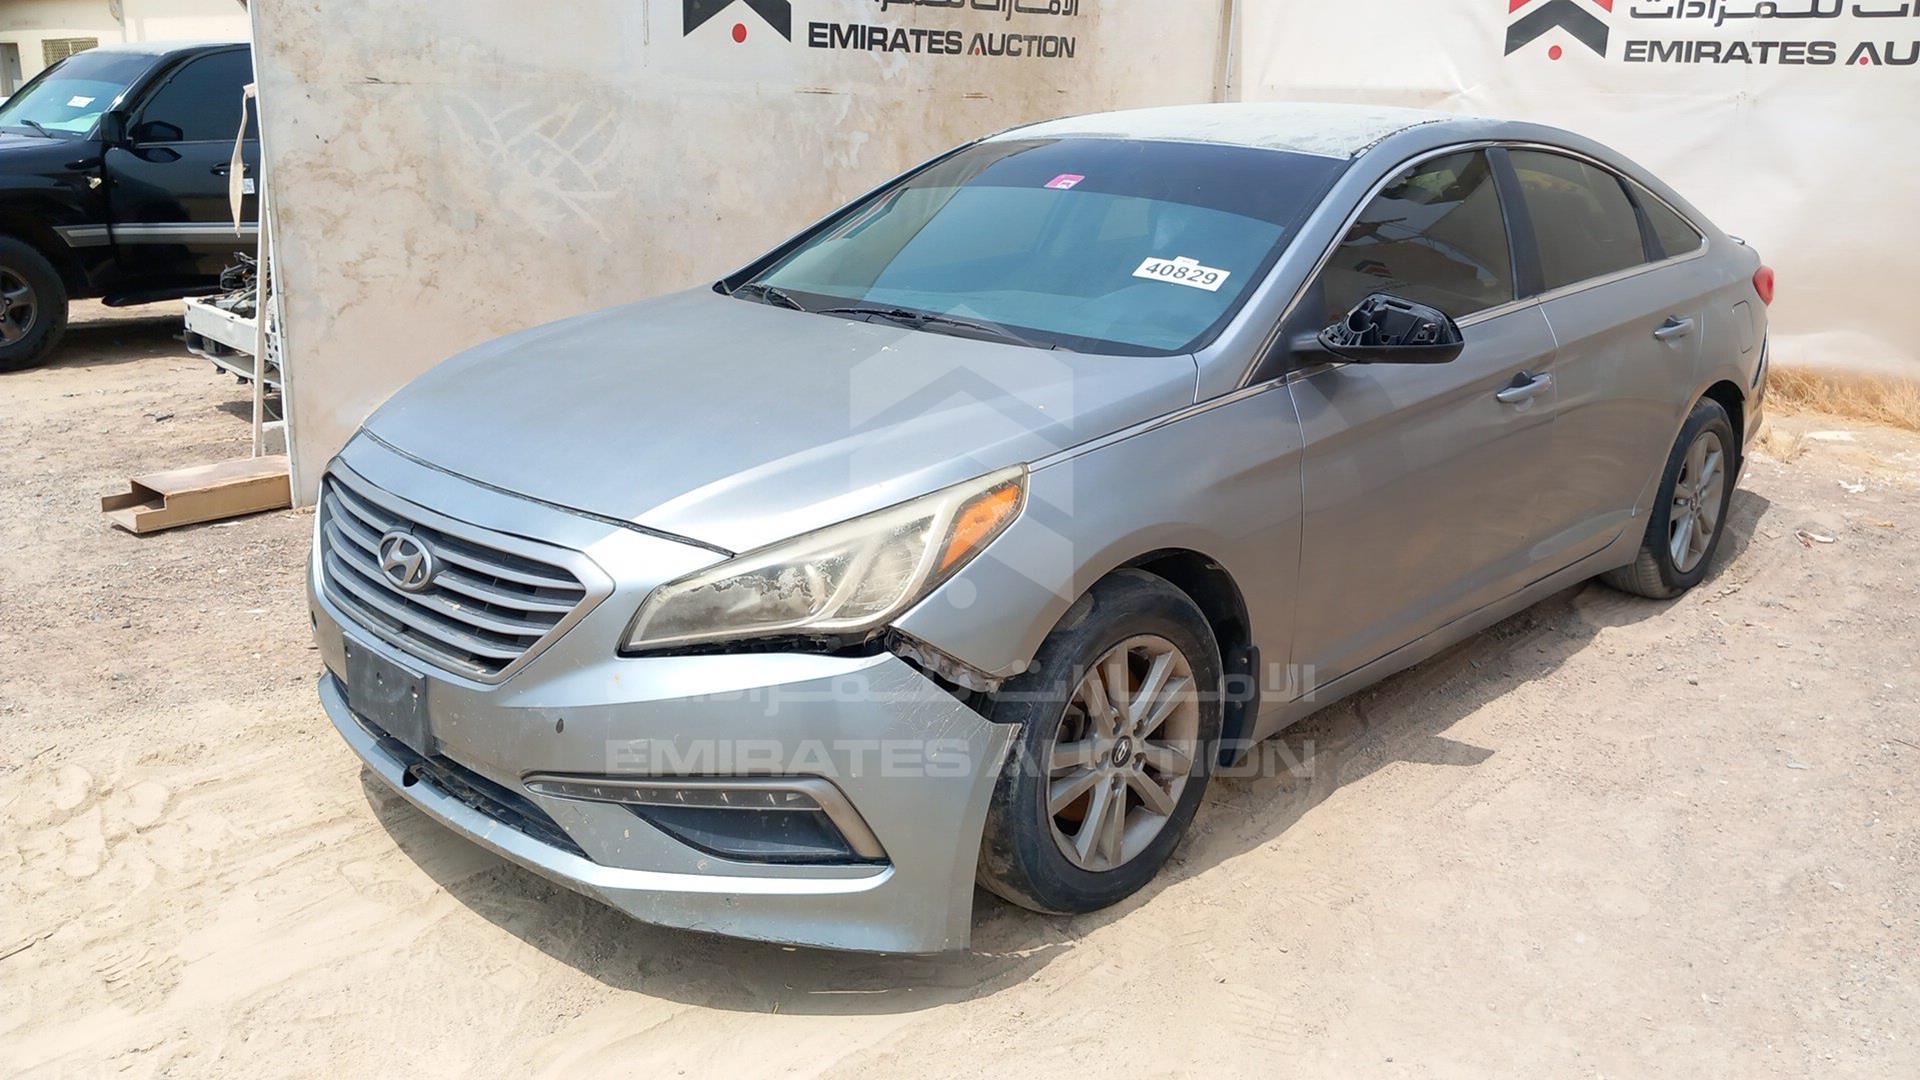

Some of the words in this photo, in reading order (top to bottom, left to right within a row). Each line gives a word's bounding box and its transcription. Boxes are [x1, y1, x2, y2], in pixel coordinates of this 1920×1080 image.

[808, 22, 962, 54] EMIRATES
[967, 33, 1075, 58] AUCTION
[1623, 40, 1837, 65] EMIRATES
[1145, 262, 1218, 285] 40829
